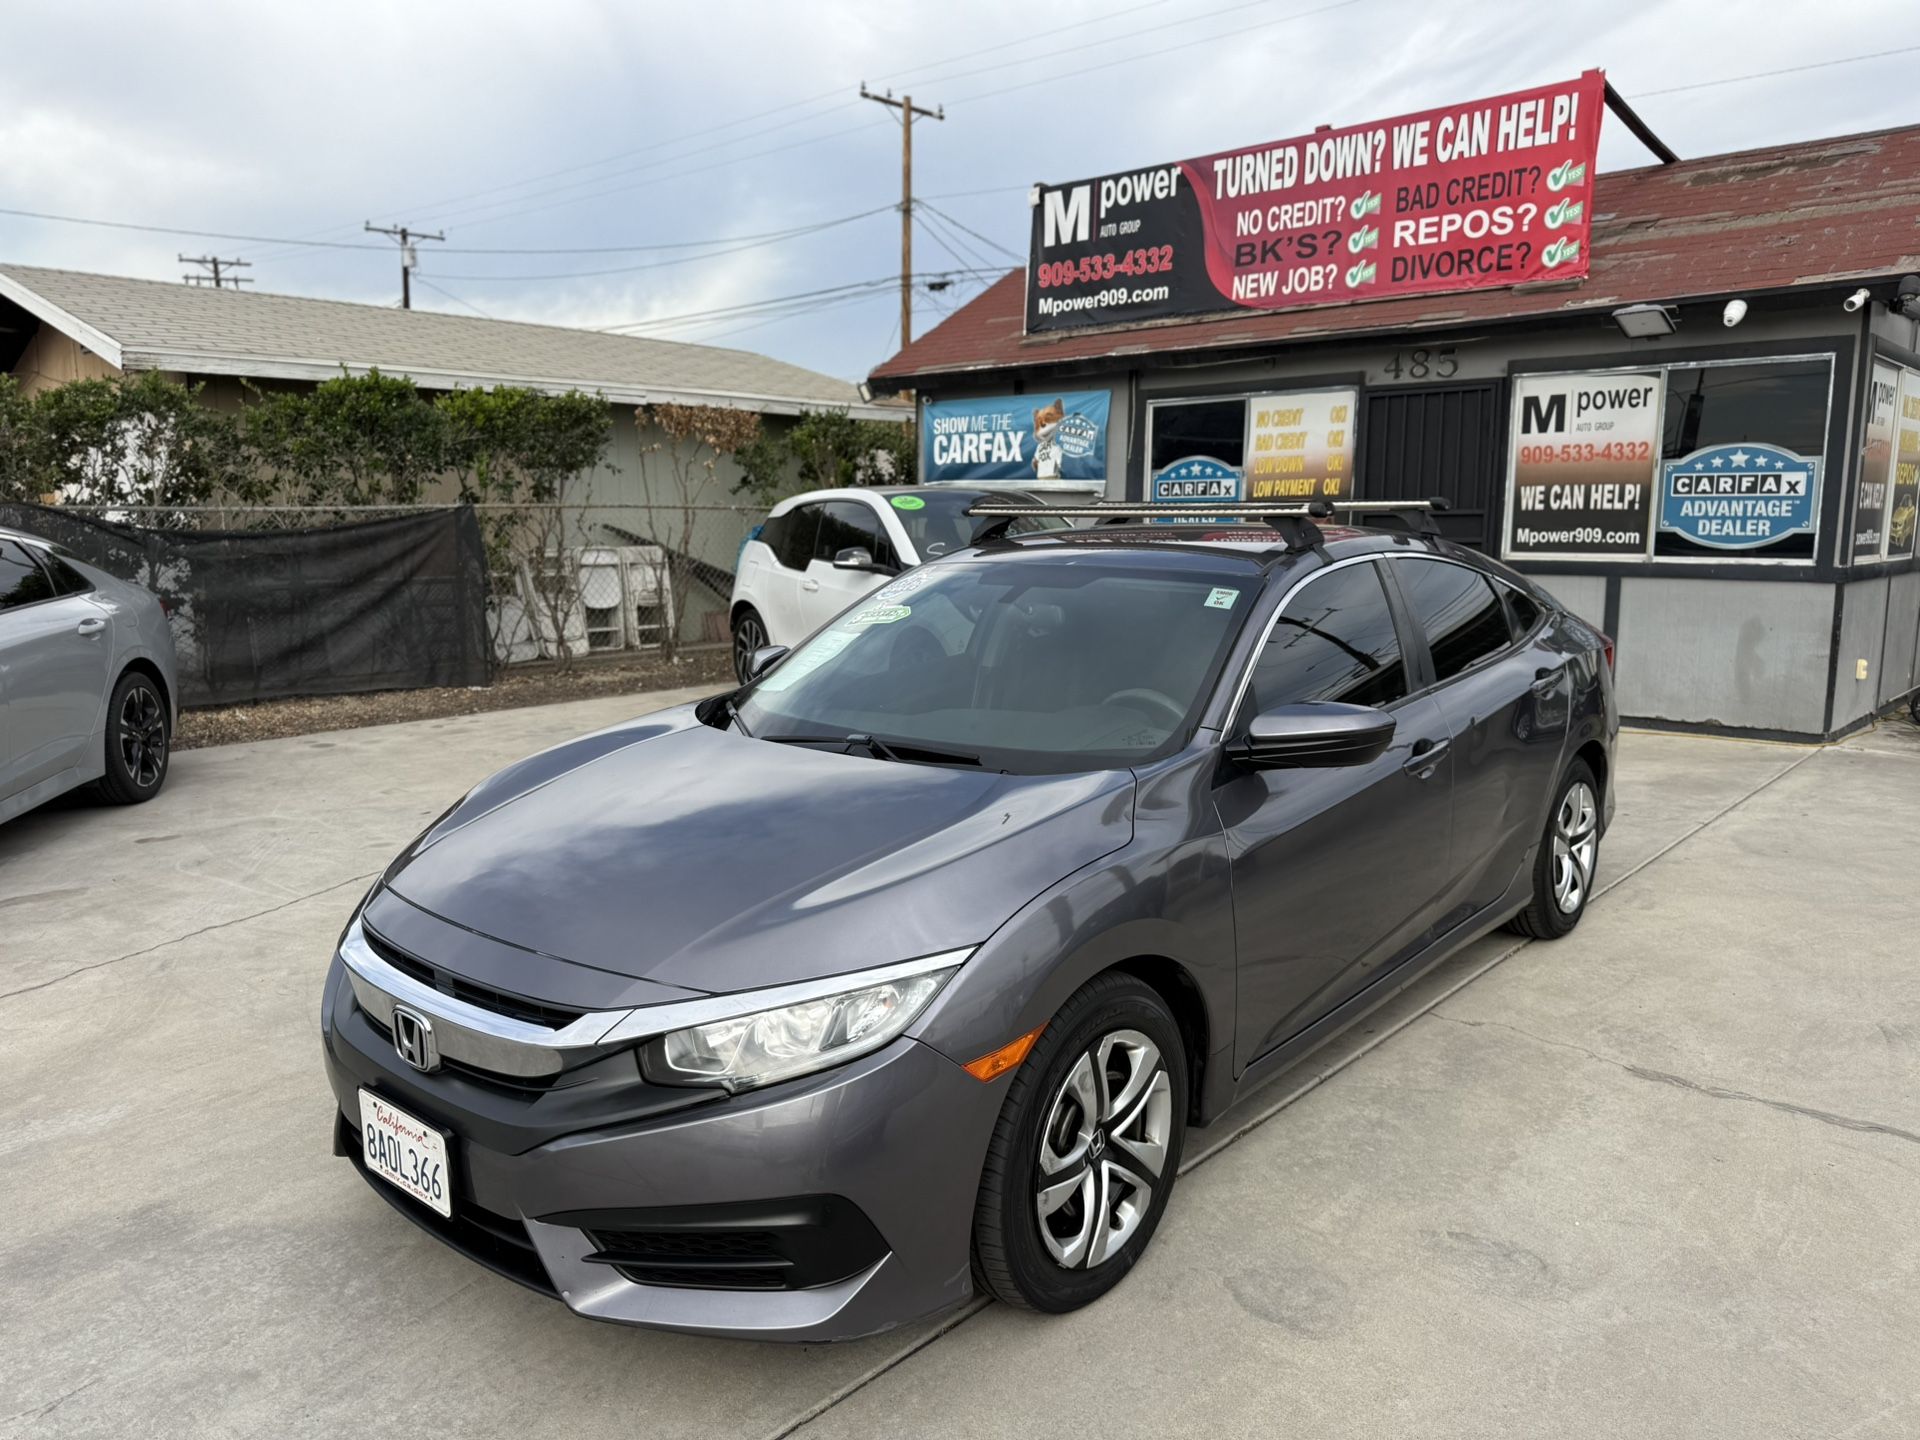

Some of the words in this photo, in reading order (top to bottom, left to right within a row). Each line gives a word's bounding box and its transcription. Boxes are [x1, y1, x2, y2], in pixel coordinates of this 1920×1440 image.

[1213, 146, 1298, 200] TURNED
[1304, 129, 1386, 185] DOWN?
[1392, 120, 1431, 170] WE
[1436, 108, 1491, 163] CAN
[1496, 92, 1579, 152] HELP!
[1396, 182, 1440, 213] BAD
[1446, 165, 1541, 206] CREDIT?
[1044, 185, 1091, 247] M
[1100, 166, 1181, 219] power
[1236, 209, 1263, 237] NO
[1267, 195, 1346, 233] CREDIT?
[1100, 222, 1116, 238] AUTO
[1119, 219, 1141, 235] GROUP
[1393, 203, 1537, 248] REPOS?
[1038, 244, 1173, 288] 909-533-4332
[1391, 242, 1531, 282] DIVORCE?
[1232, 270, 1278, 300] NEW
[1282, 263, 1338, 295] JOB?
[1038, 285, 1169, 317] Mpower909.com
[1384, 347, 1458, 379] 485
[934, 416, 969, 434] SHOW
[971, 414, 988, 431] ME
[991, 413, 1012, 430] THE
[1521, 394, 1566, 434] M
[1576, 386, 1653, 418] power
[1576, 423, 1591, 432] AUTO
[1595, 421, 1615, 432] GROUP
[934, 431, 1026, 466] CARFAX
[1255, 457, 1273, 474] LOW
[1275, 456, 1304, 473] DOWN
[1327, 454, 1344, 472] OK!
[1521, 441, 1649, 464] 909-533-4332
[1160, 482, 1232, 496] CARFAX
[1253, 480, 1273, 497] LOW
[1273, 478, 1316, 496] PAYMENT
[1323, 478, 1341, 495] OK!
[1520, 485, 1545, 511] WE
[1549, 484, 1585, 510] CAN
[1590, 484, 1641, 510] HELP!
[1516, 527, 1640, 546] Mpower909.com
[1697, 519, 1771, 536] DEALER
[377, 1105, 429, 1149] California
